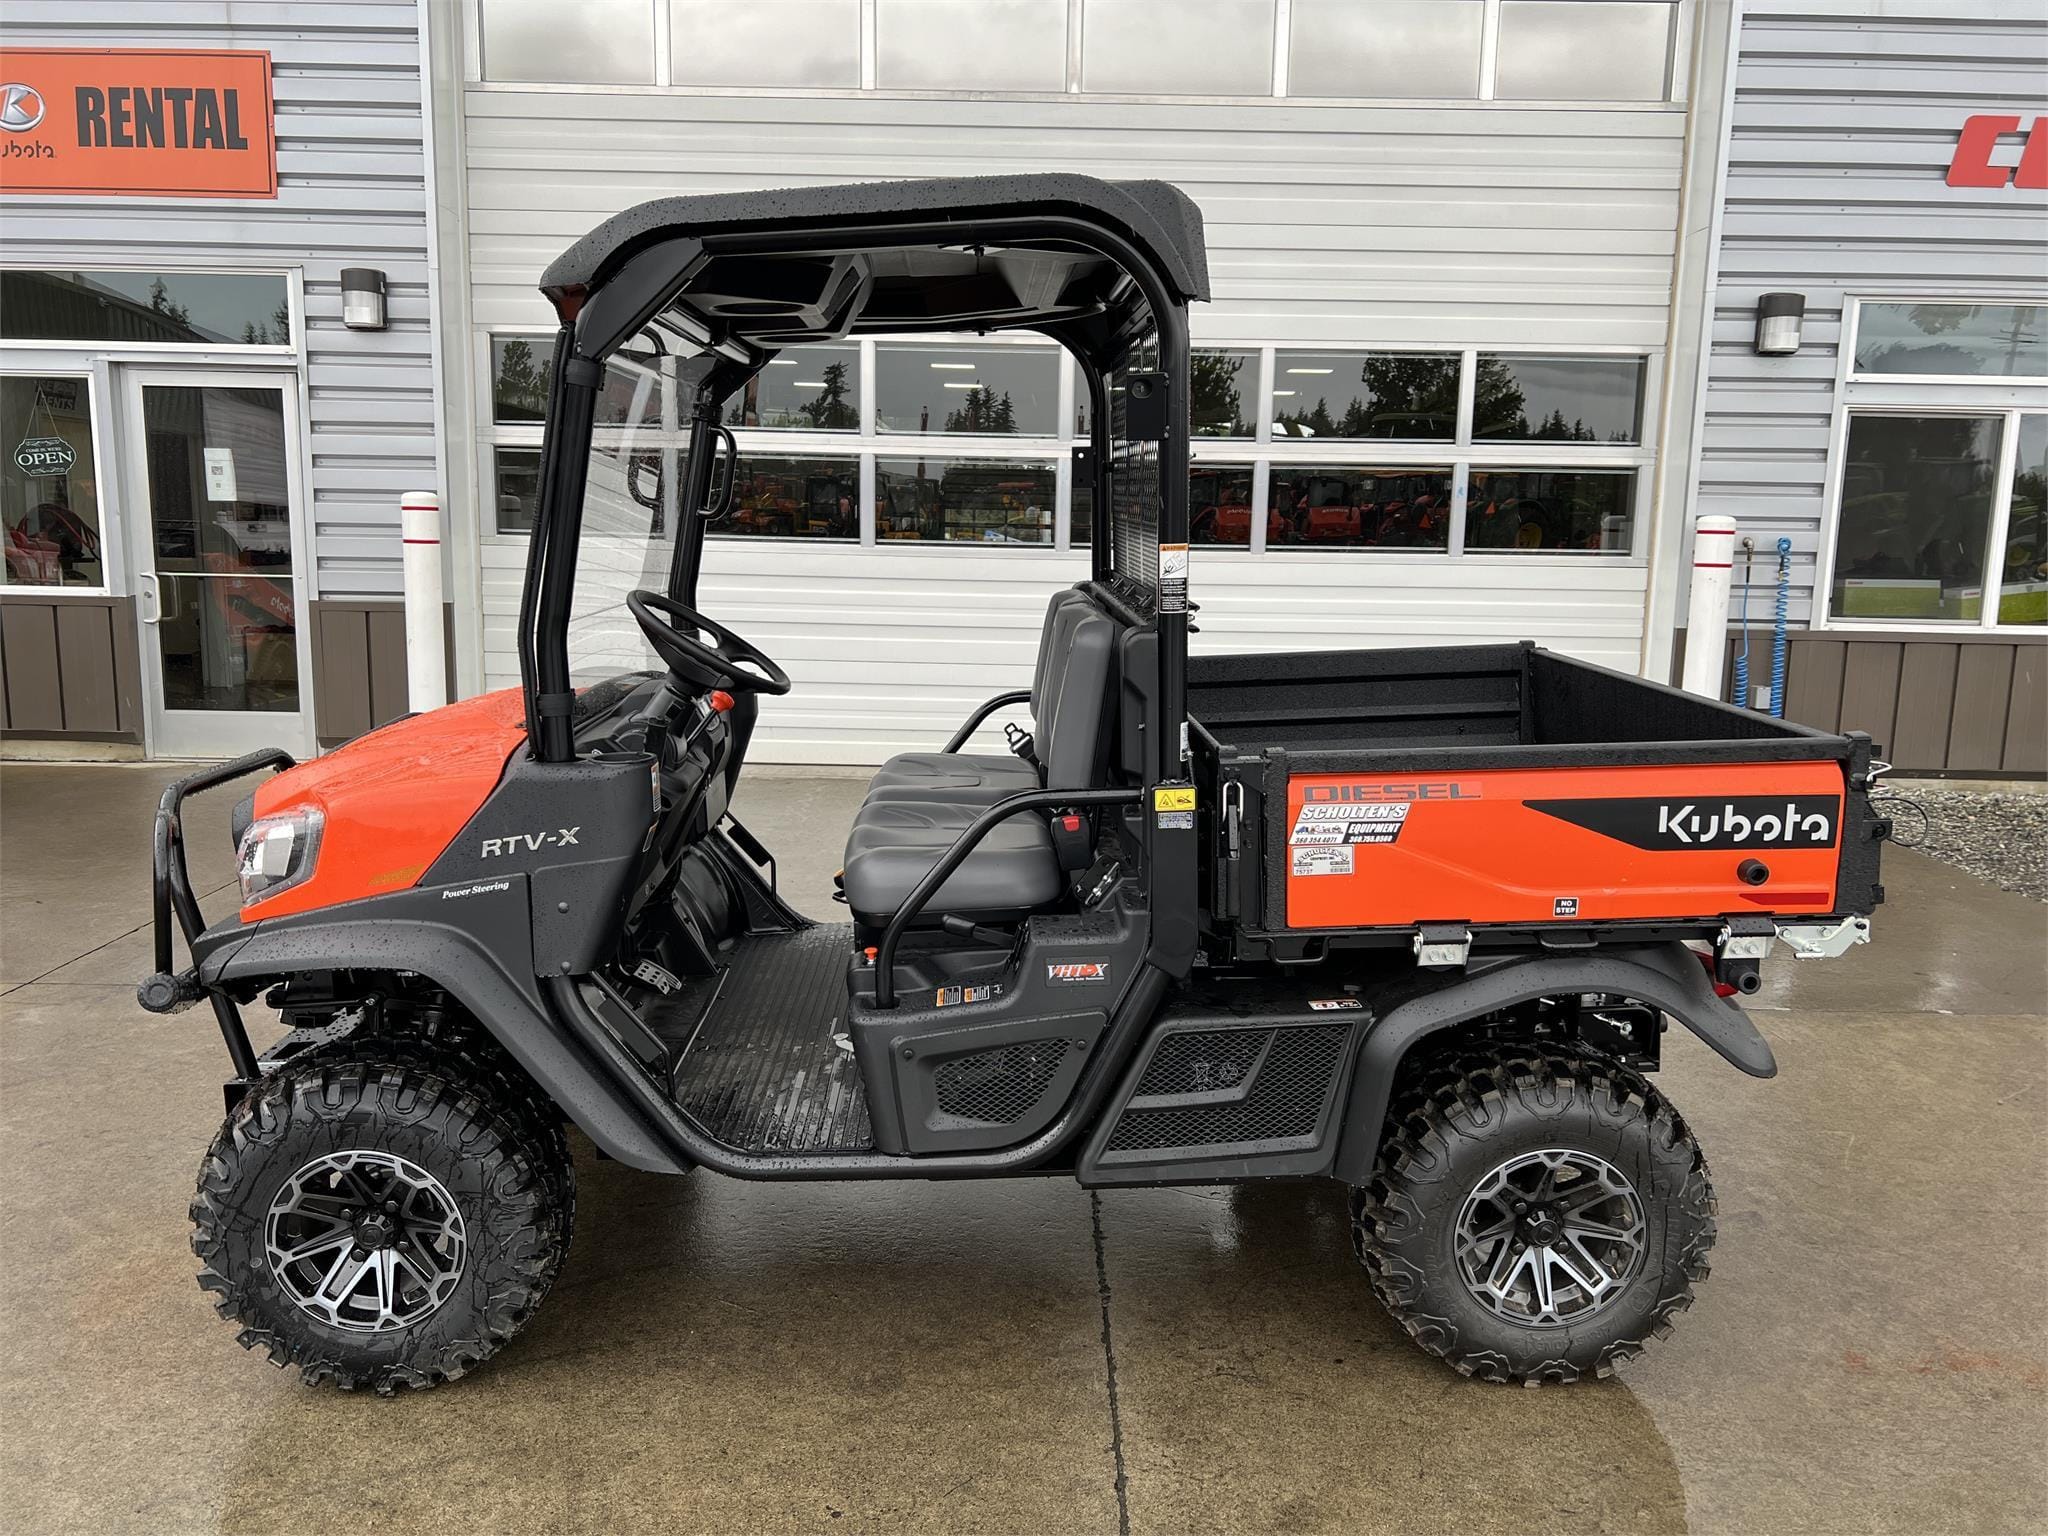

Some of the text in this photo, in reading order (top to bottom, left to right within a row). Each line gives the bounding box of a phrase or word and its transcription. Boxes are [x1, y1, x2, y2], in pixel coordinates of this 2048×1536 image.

[75, 86, 248, 150] RENTAL
[0, 140, 54, 158] ubota
[18, 451, 73, 465] OPEN
[1304, 783, 1481, 801] DIESEL
[1301, 805, 1407, 820] SCHOLTEN'S
[1348, 822, 1402, 834] EQUIPMENT
[1658, 803, 1830, 843] Kubota
[481, 826, 580, 858] RTV-X
[442, 881, 509, 899] Power Steering
